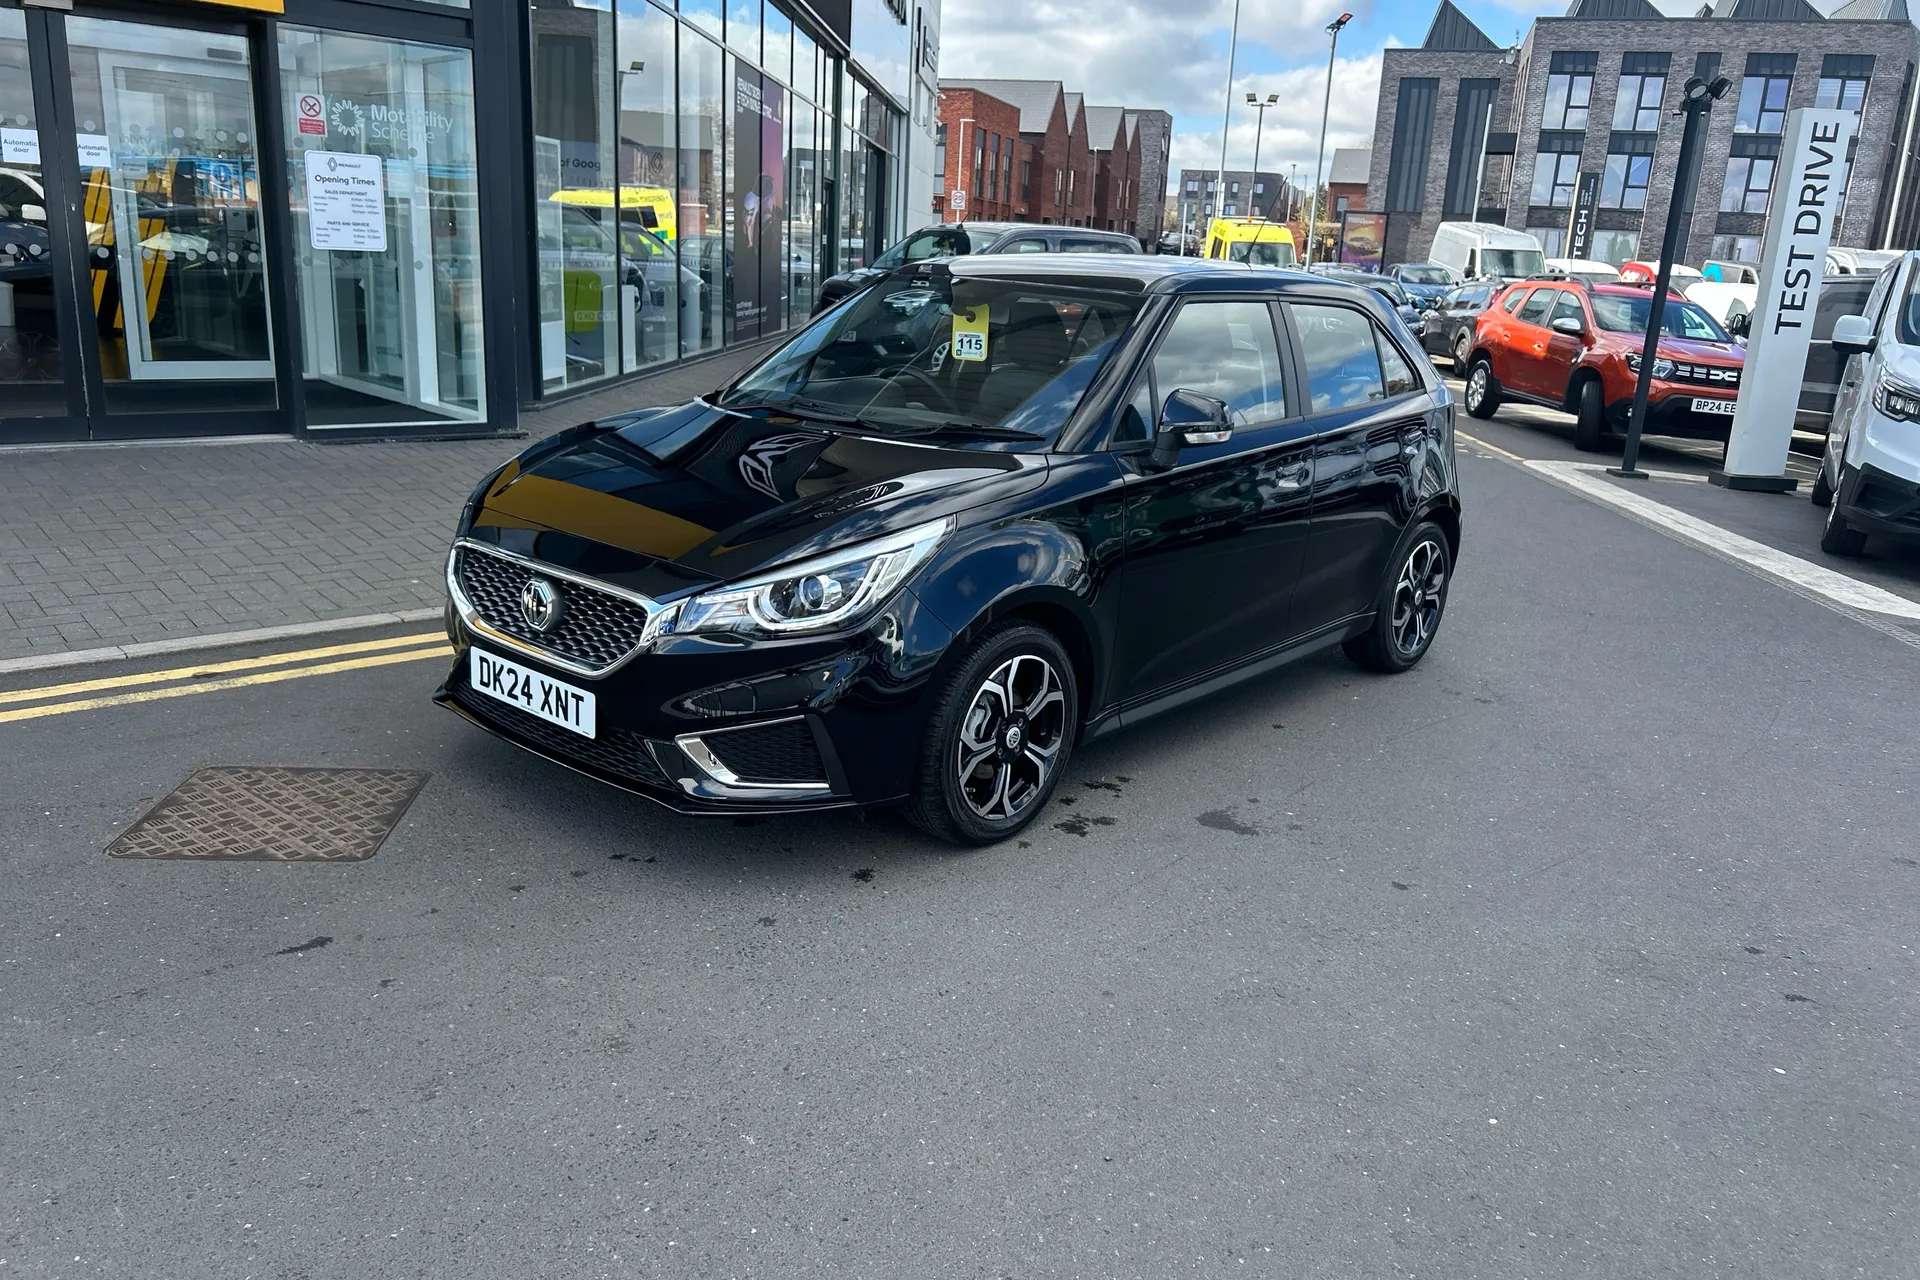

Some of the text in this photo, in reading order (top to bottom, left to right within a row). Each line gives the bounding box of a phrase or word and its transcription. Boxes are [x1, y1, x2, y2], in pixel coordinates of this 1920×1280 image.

[371, 104, 454, 133] Motability
[3, 138, 37, 147] Automatic
[315, 174, 375, 186] Opening Times
[1573, 209, 1589, 259] TECH
[1774, 122, 1840, 335] TEST DRIVE
[958, 338, 983, 351] 115
[1695, 400, 1721, 412] BP24
[478, 655, 585, 727] DK24 XNT
